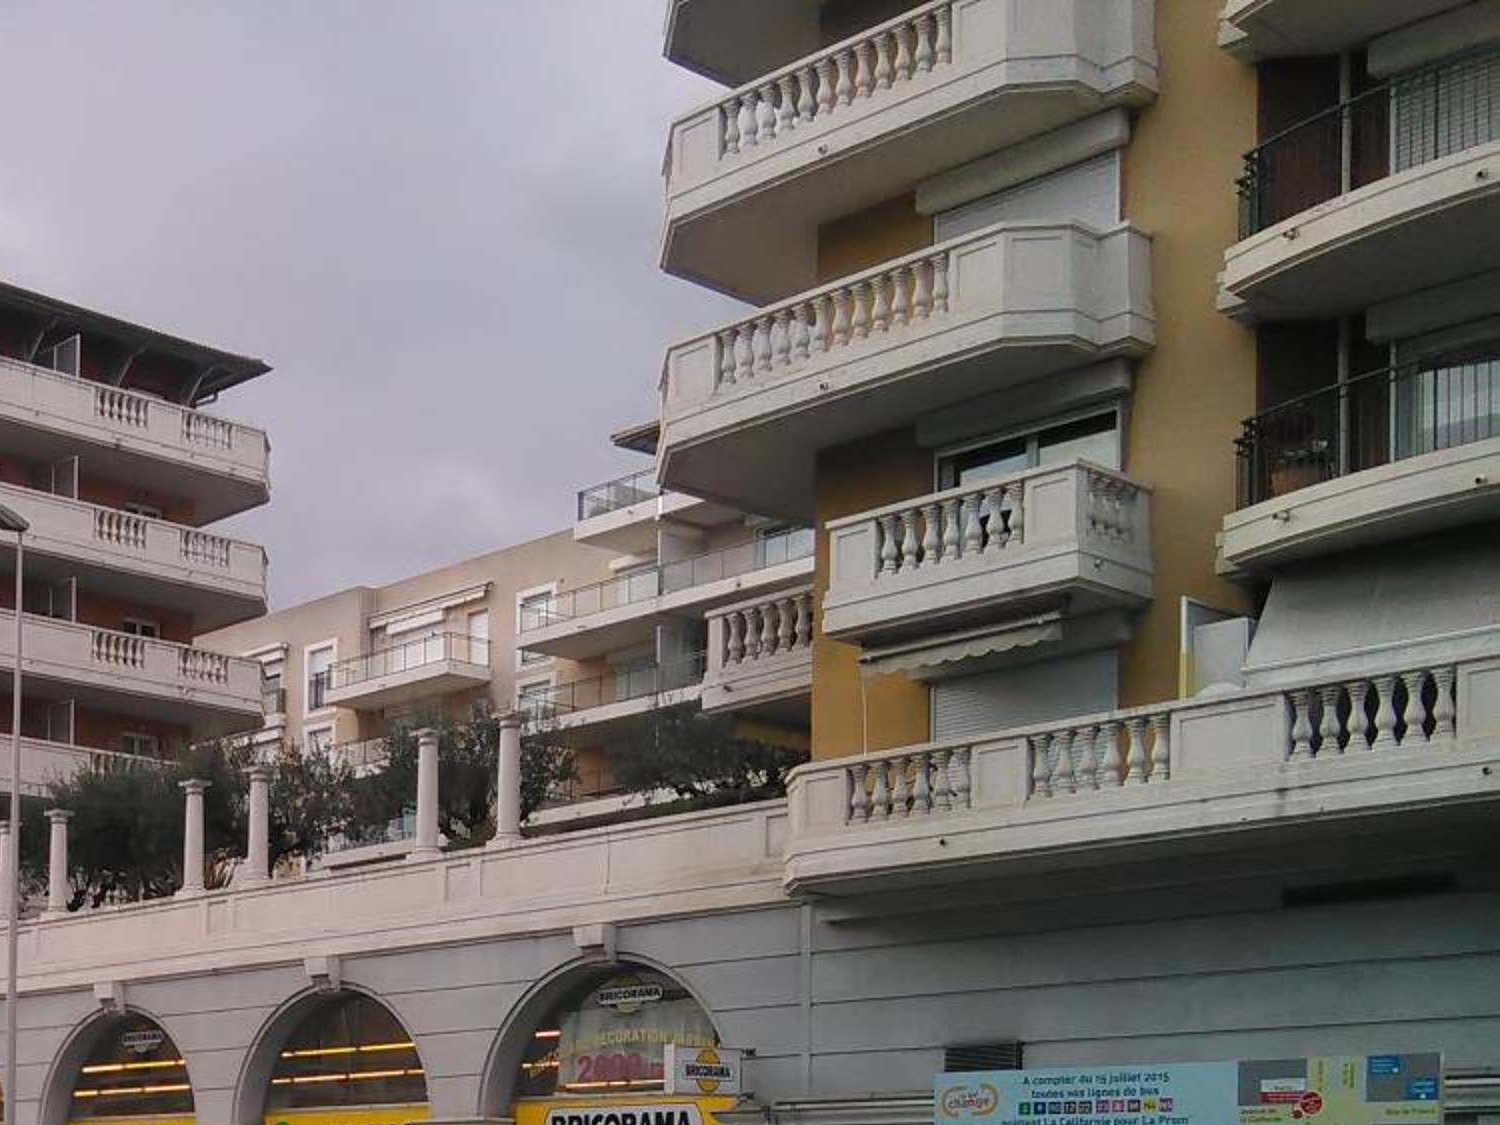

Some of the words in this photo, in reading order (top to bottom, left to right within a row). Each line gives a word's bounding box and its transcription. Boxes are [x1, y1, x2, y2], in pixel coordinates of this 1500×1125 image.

[599, 986, 661, 1000] BRICORAMA
[686, 1064, 730, 1077] BRICORAMA
[1032, 1075, 1076, 1087] compter
[1079, 1073, 1093, 1084] du
[1108, 1072, 1141, 1085] juillet
[1031, 1089, 1064, 1099] toutes
[1088, 1087, 1121, 1099] lignes
[1124, 1086, 1137, 1096] de
[1140, 1086, 1160, 1096] bus
[1142, 1116, 1155, 1125] La
[1158, 1115, 1188, 1125] Prom
